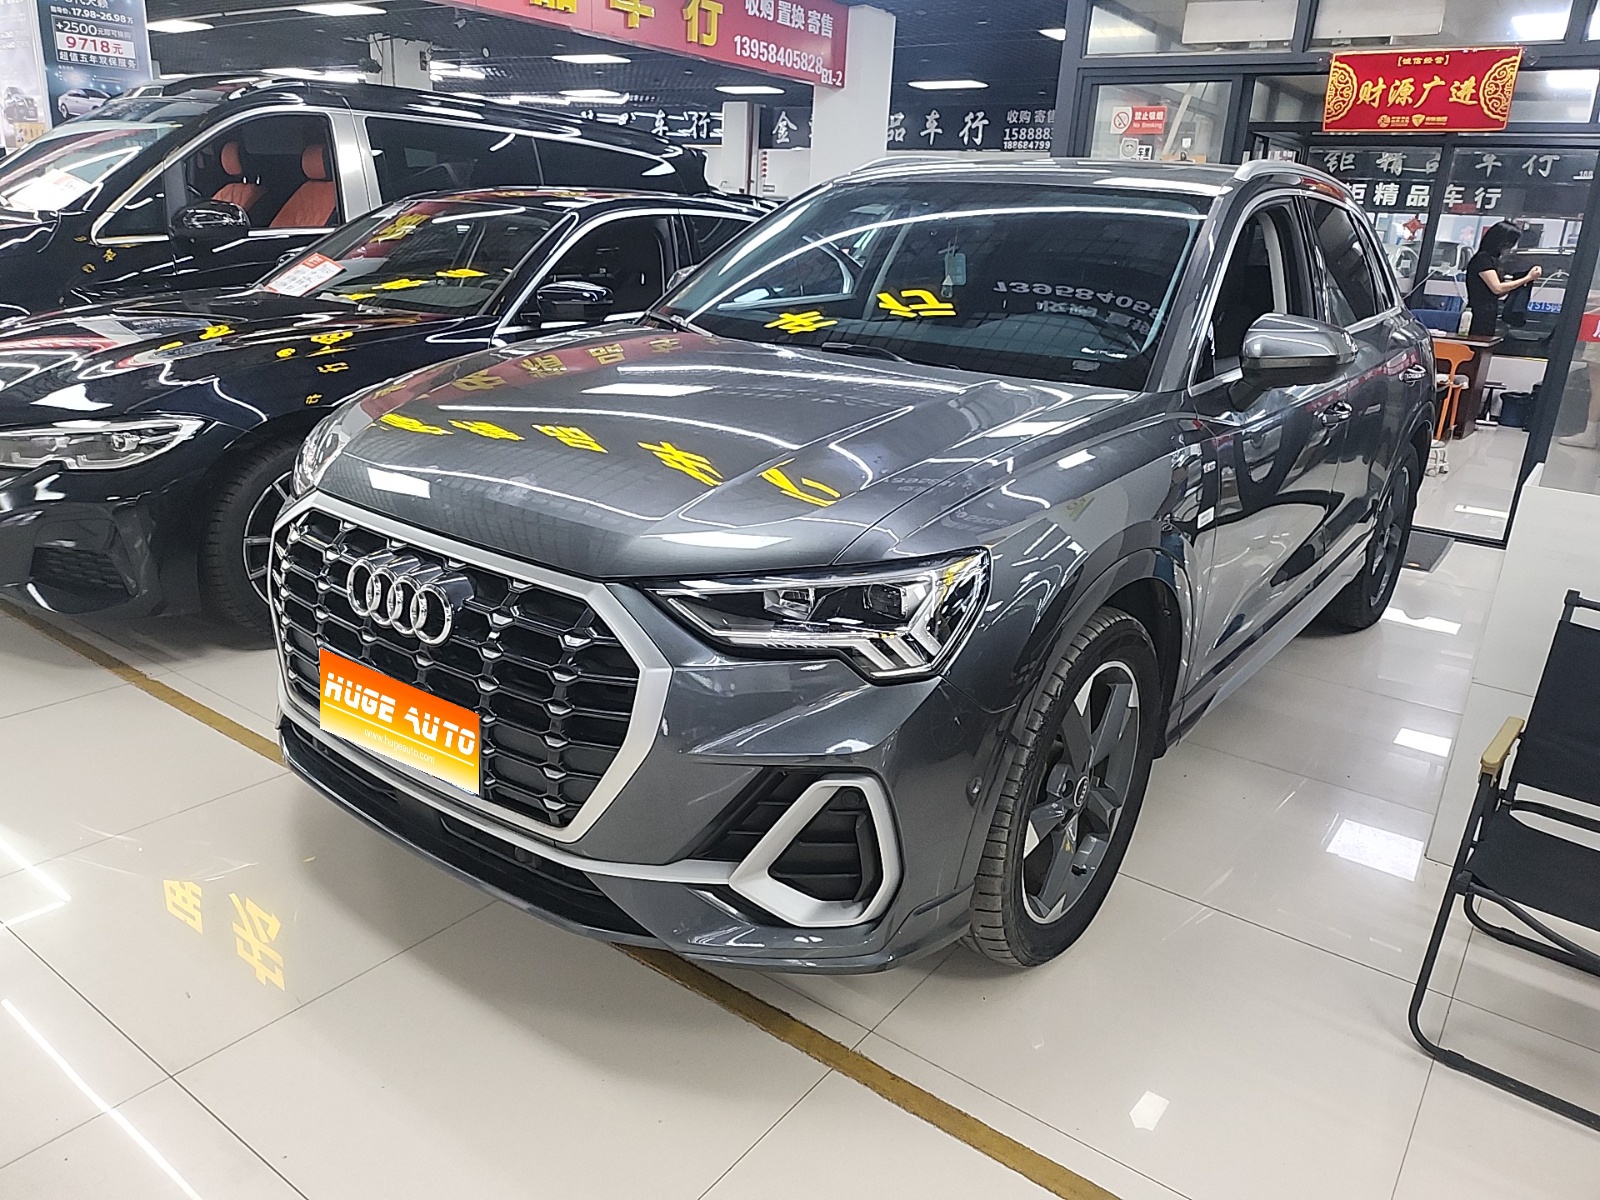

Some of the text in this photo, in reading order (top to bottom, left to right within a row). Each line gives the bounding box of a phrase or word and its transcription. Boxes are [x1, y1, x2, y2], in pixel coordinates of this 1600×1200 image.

[745, 0, 834, 38] 收购 置换 寄售
[66, 36, 124, 55] 9718元
[734, 35, 823, 75] 13958405828
[821, 69, 842, 86] B1-2
[1356, 75, 1478, 108] 财源广进
[1007, 109, 1031, 124] 收购
